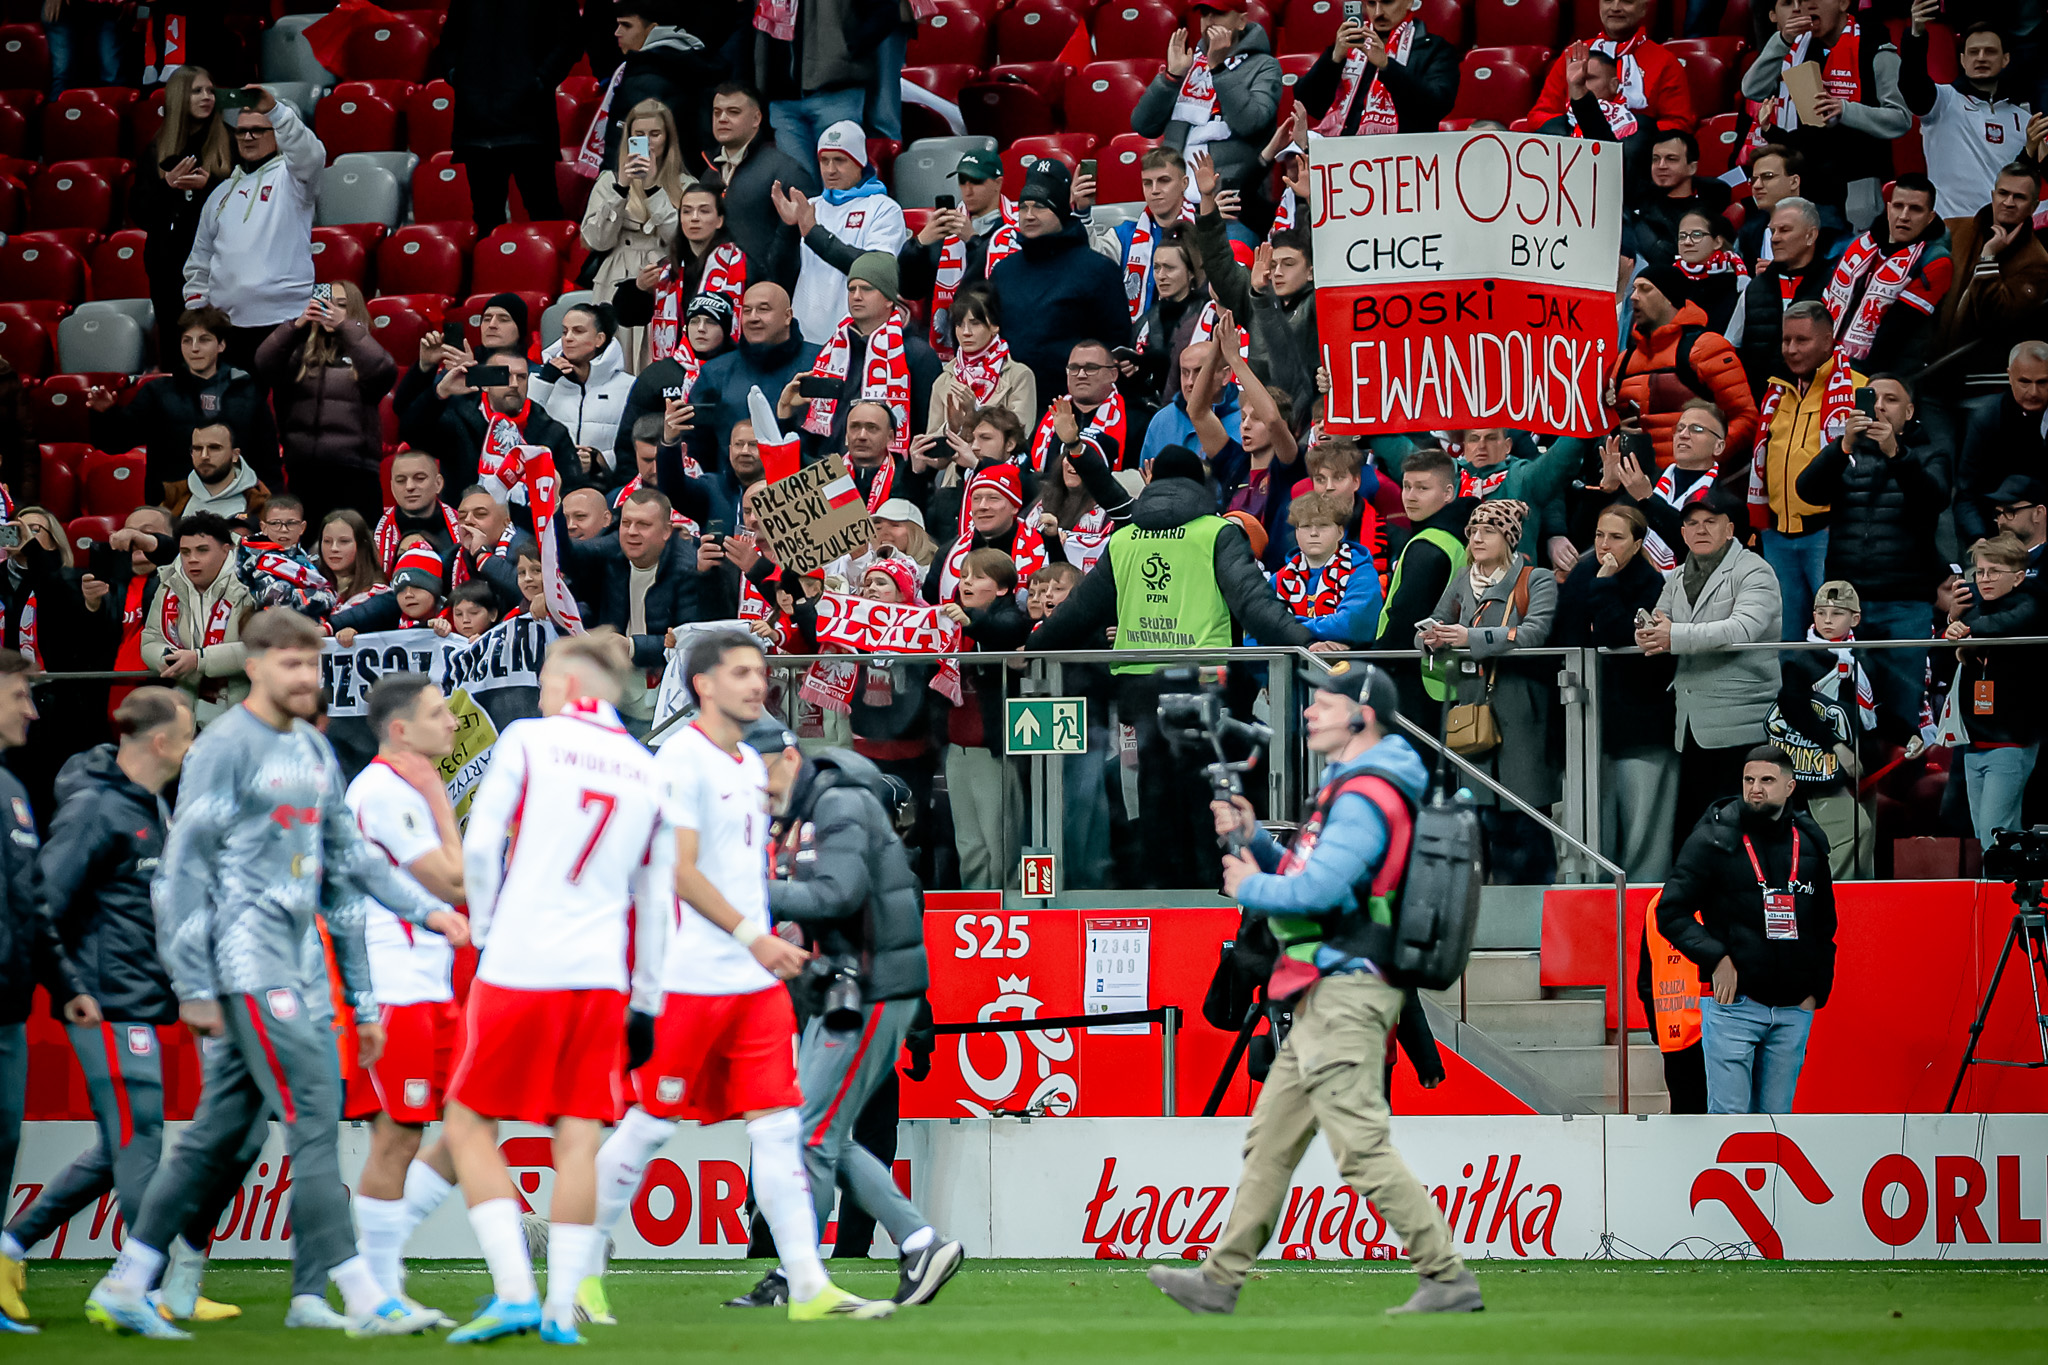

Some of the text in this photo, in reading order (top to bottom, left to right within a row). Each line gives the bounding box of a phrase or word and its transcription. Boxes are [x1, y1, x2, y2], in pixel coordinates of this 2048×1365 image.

[1311, 153, 1440, 228] JESTEM
[1346, 233, 1569, 273] CHCĘ BYĆ
[1526, 293, 1584, 332] JAK
[864, 390, 908, 400] BIAŁO
[1131, 527, 1186, 541] STEWARD
[1146, 594, 1169, 604] PZPN
[806, 595, 940, 650] OLSKA
[567, 789, 618, 886] 7
[954, 914, 1031, 960] S25
[1082, 1157, 1230, 1259] Łącz
[1861, 1153, 2048, 1247] ORL
